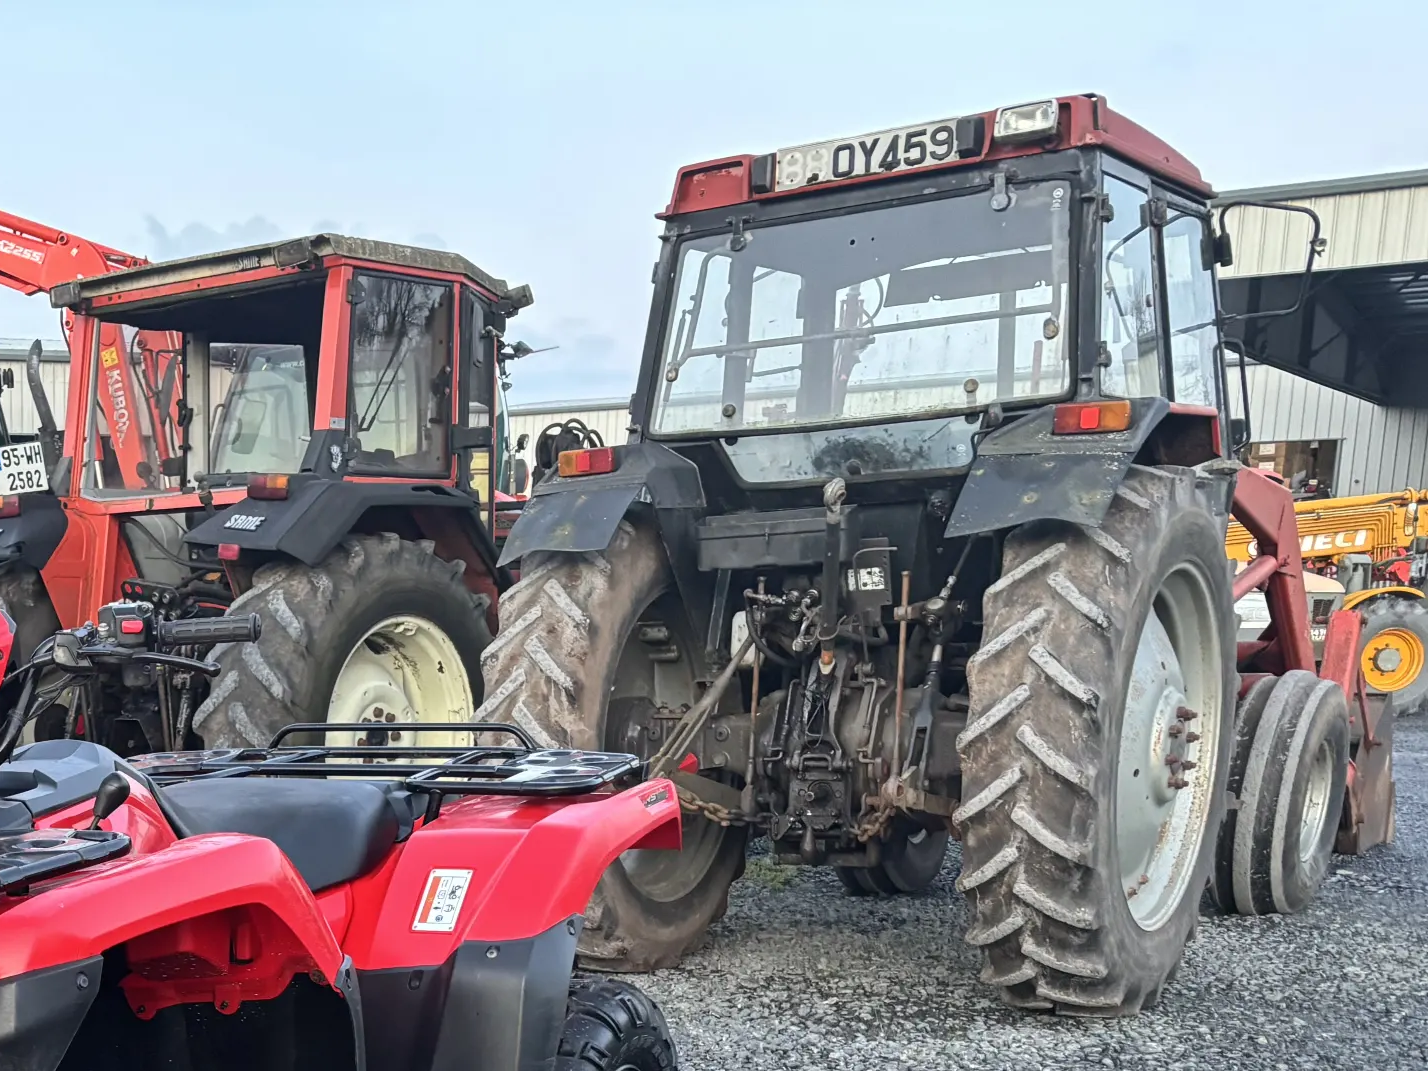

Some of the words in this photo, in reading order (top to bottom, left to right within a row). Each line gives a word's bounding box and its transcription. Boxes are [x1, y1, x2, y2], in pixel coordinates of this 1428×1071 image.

[1, 445, 43, 468] 95-WH
[7, 469, 43, 491] 2582
[1298, 529, 1367, 552] IECI
